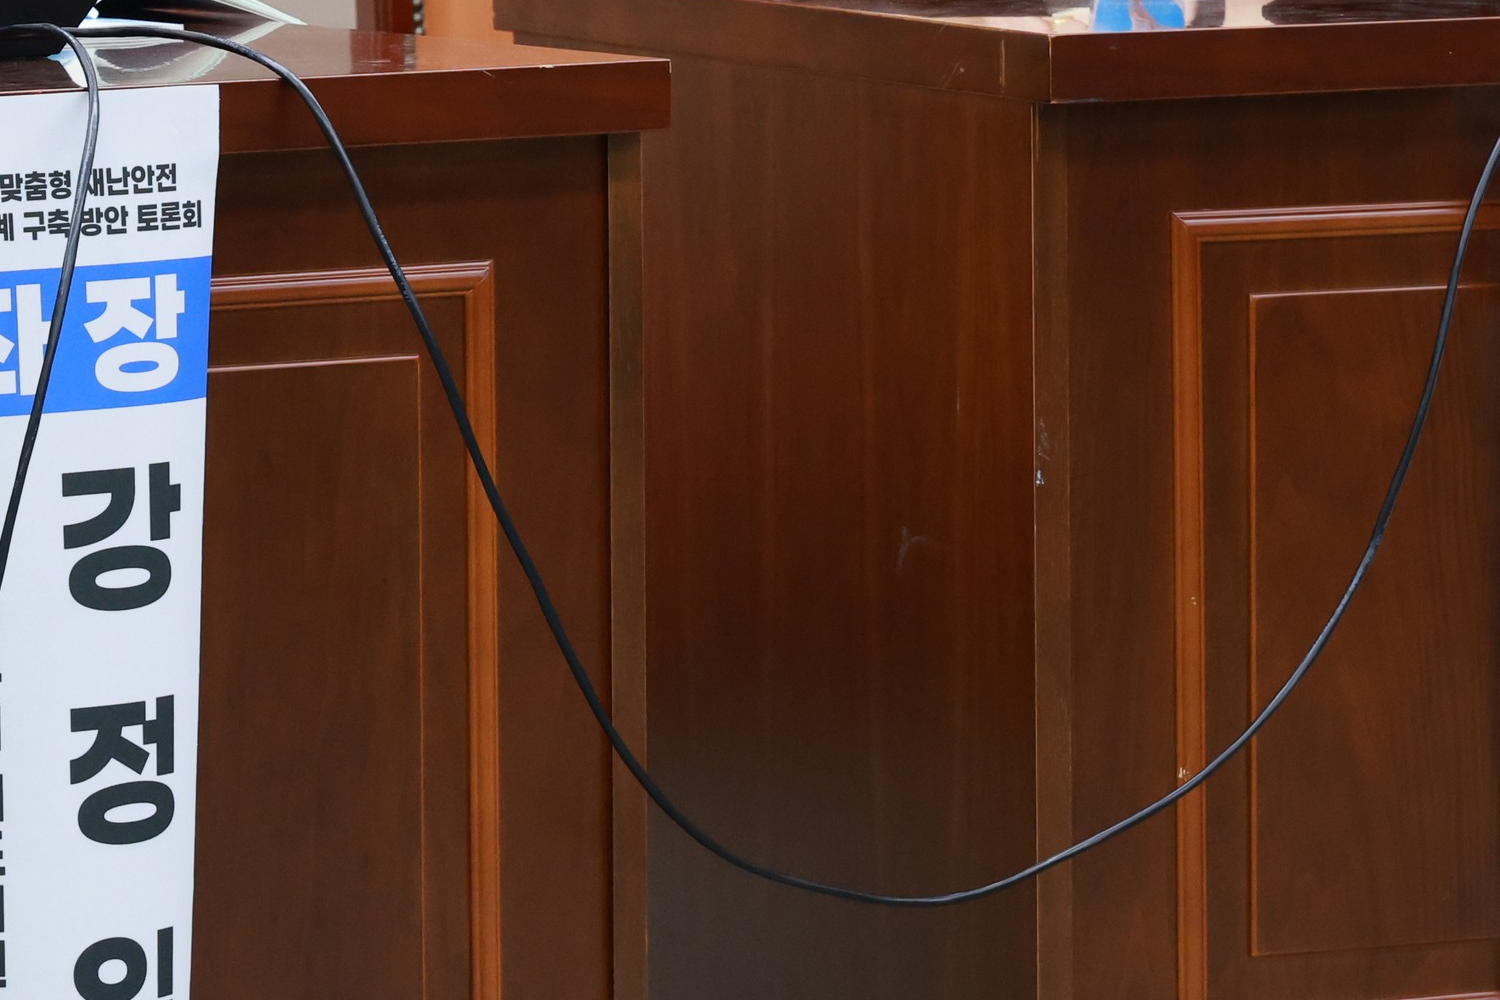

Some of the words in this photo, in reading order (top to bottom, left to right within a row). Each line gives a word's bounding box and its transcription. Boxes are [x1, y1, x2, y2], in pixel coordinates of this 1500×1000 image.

[0, 169, 72, 203] 맞춤형
[23, 209, 71, 241] 구축
[79, 205, 128, 237] 방안
[136, 200, 202, 232] 토론회
